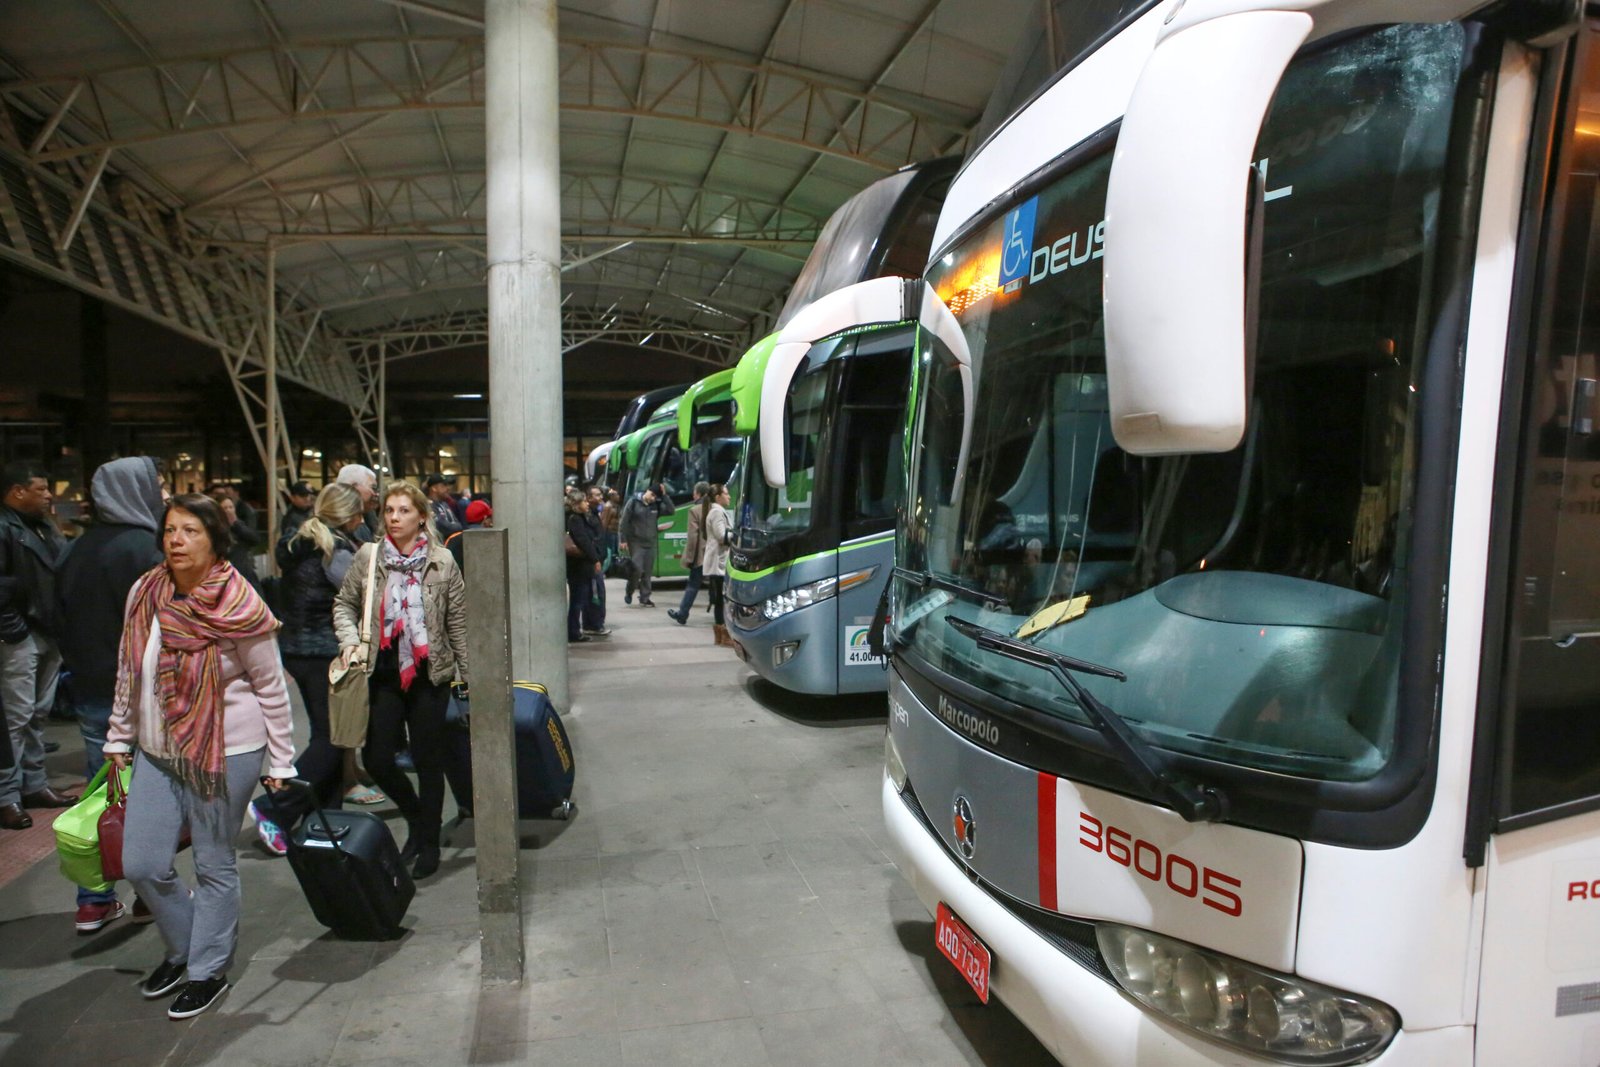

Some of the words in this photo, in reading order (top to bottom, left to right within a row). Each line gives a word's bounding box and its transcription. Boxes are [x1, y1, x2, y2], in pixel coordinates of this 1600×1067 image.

[1029, 220, 1105, 285] DEUS
[938, 694, 999, 745] Marcopolo
[1079, 811, 1242, 917] 36005
